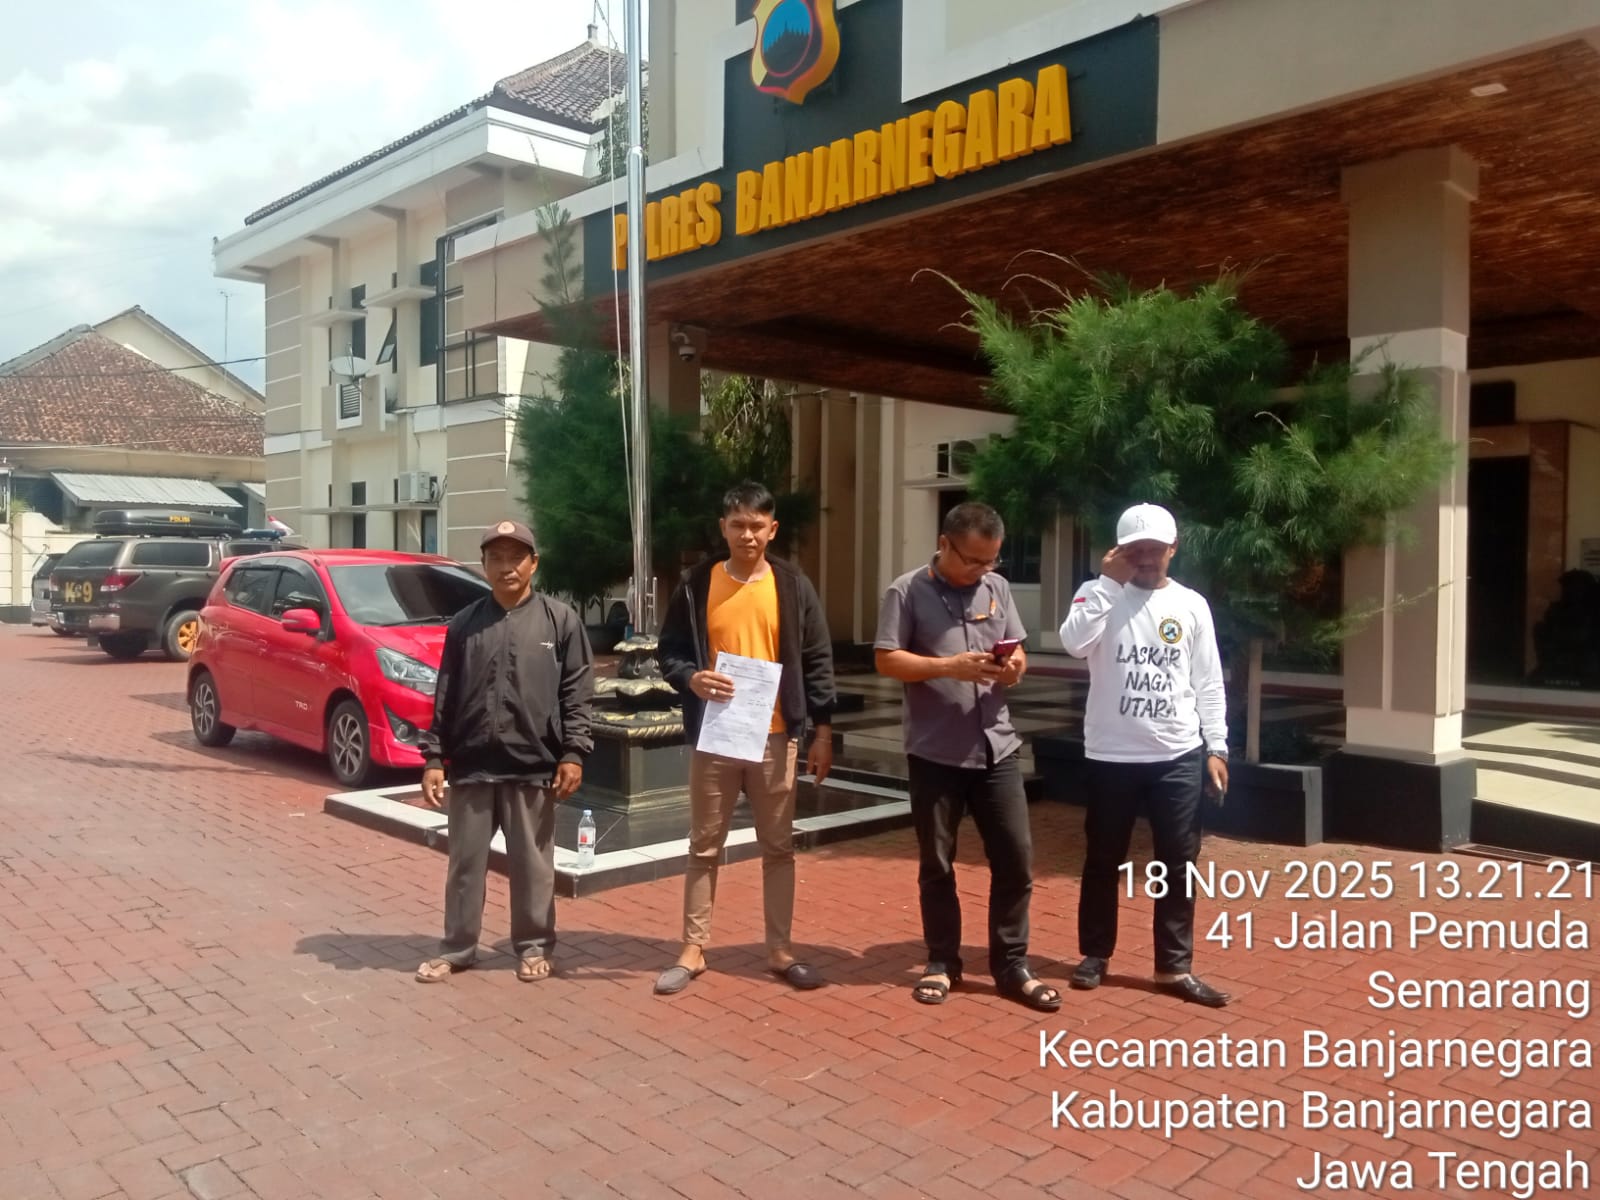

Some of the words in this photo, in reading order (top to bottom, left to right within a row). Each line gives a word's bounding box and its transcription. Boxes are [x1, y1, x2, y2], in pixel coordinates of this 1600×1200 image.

[612, 181, 722, 271] PLRES
[735, 63, 1073, 236] BANJARNEGARA
[1116, 643, 1181, 669] LASKAR
[1125, 671, 1173, 692] NAGA
[1120, 696, 1177, 718] UTARA
